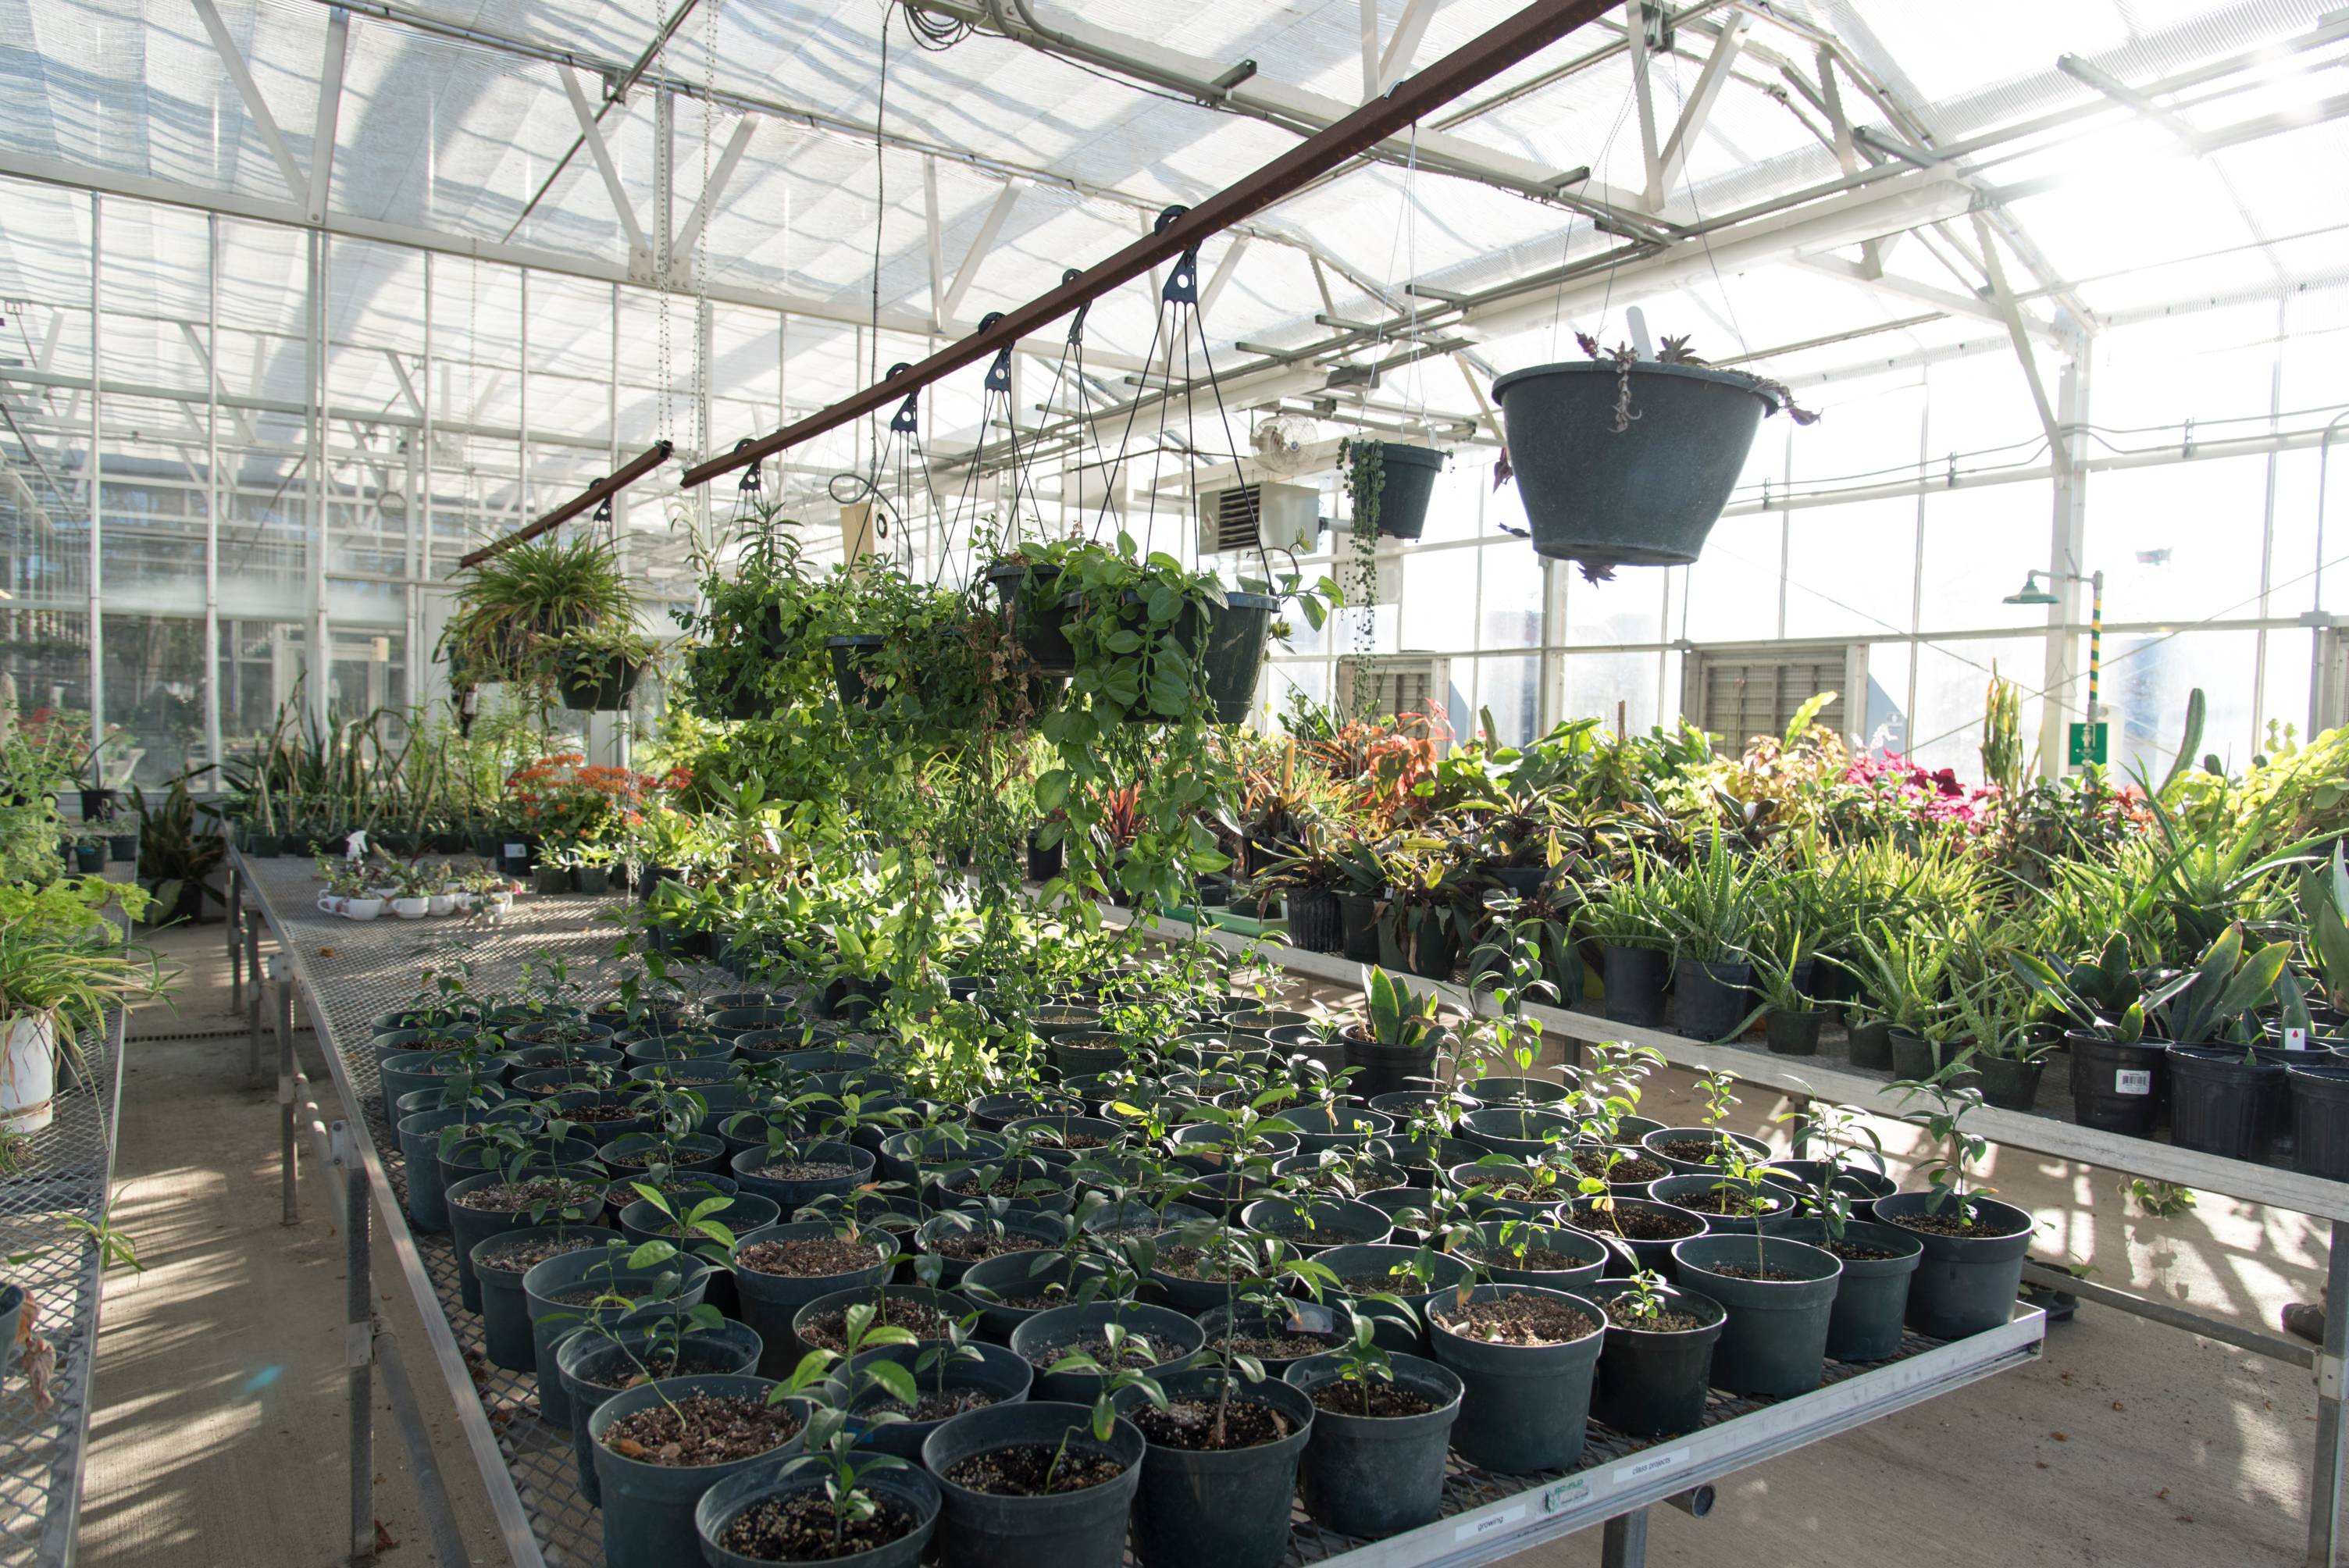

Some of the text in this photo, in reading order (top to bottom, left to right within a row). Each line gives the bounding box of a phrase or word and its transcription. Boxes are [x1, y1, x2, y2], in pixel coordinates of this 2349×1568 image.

[1631, 1456, 1671, 1475] class projects
[1477, 1516, 1504, 1531] growing
